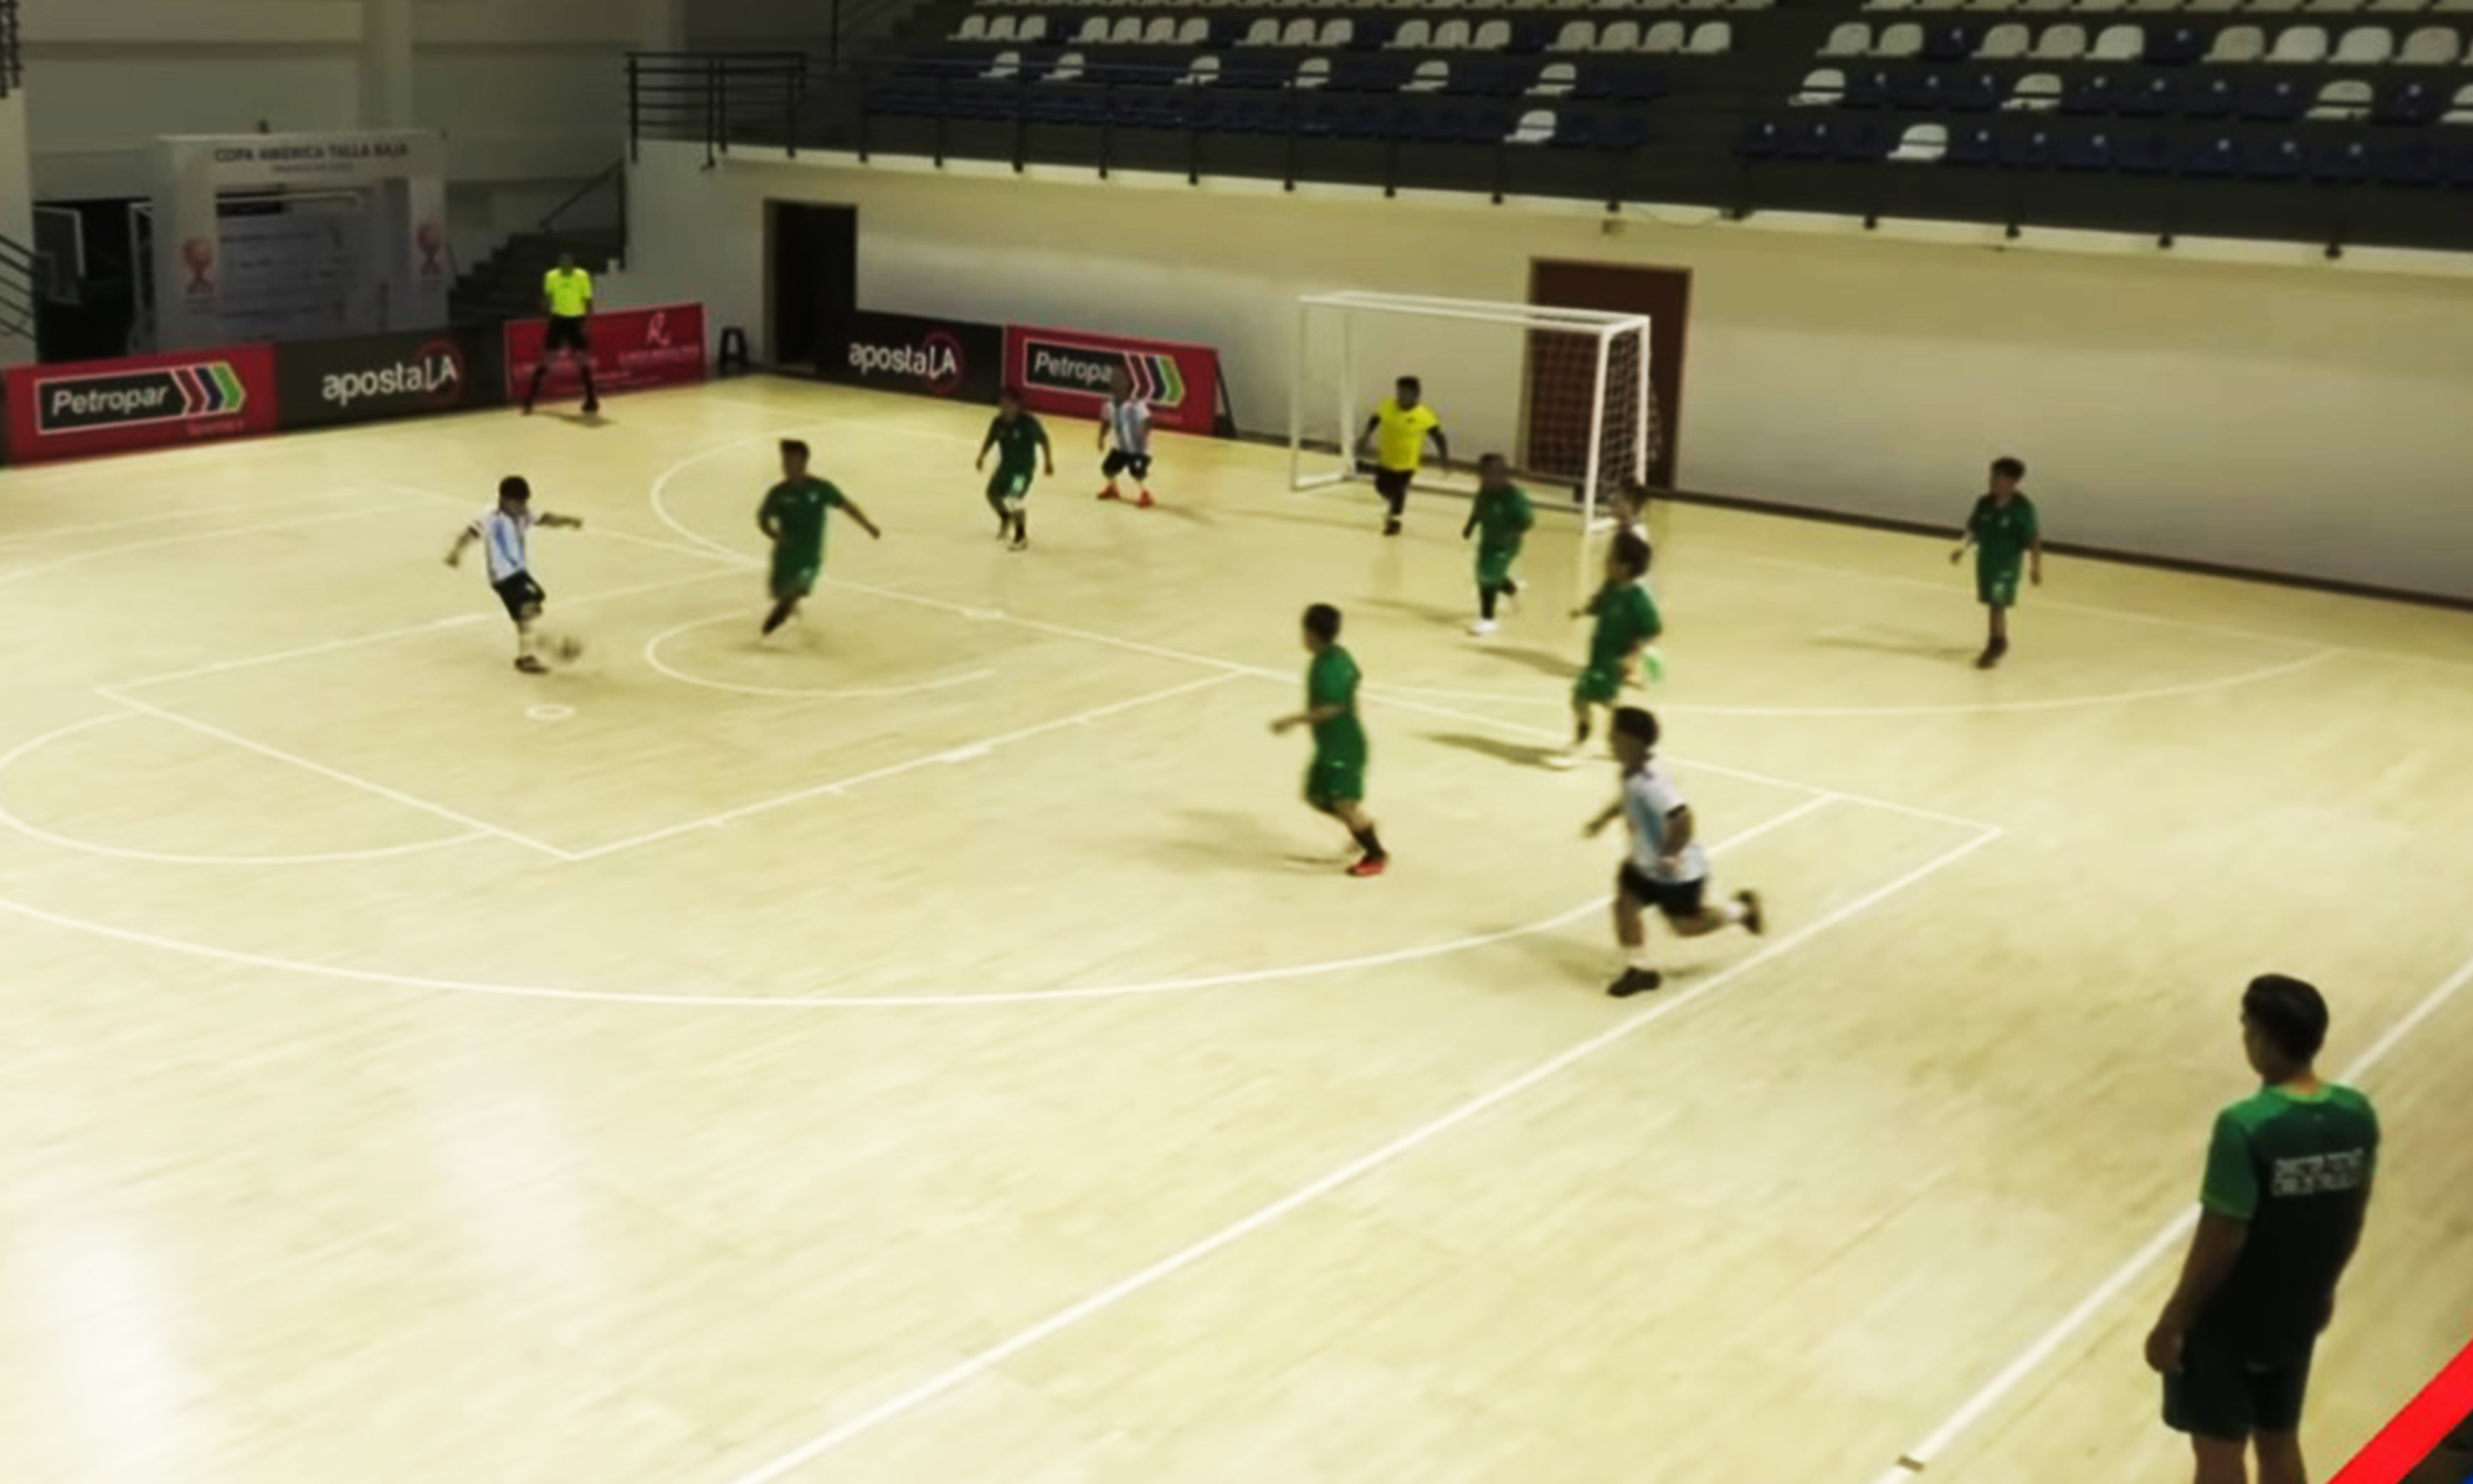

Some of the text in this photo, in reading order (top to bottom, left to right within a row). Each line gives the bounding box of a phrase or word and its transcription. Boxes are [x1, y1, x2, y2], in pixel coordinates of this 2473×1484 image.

[214, 147, 253, 162] COPA
[327, 143, 370, 158] TALLA
[373, 142, 409, 157] BAJA
[1034, 351, 1117, 386] Petropa
[52, 381, 169, 416] Petropar
